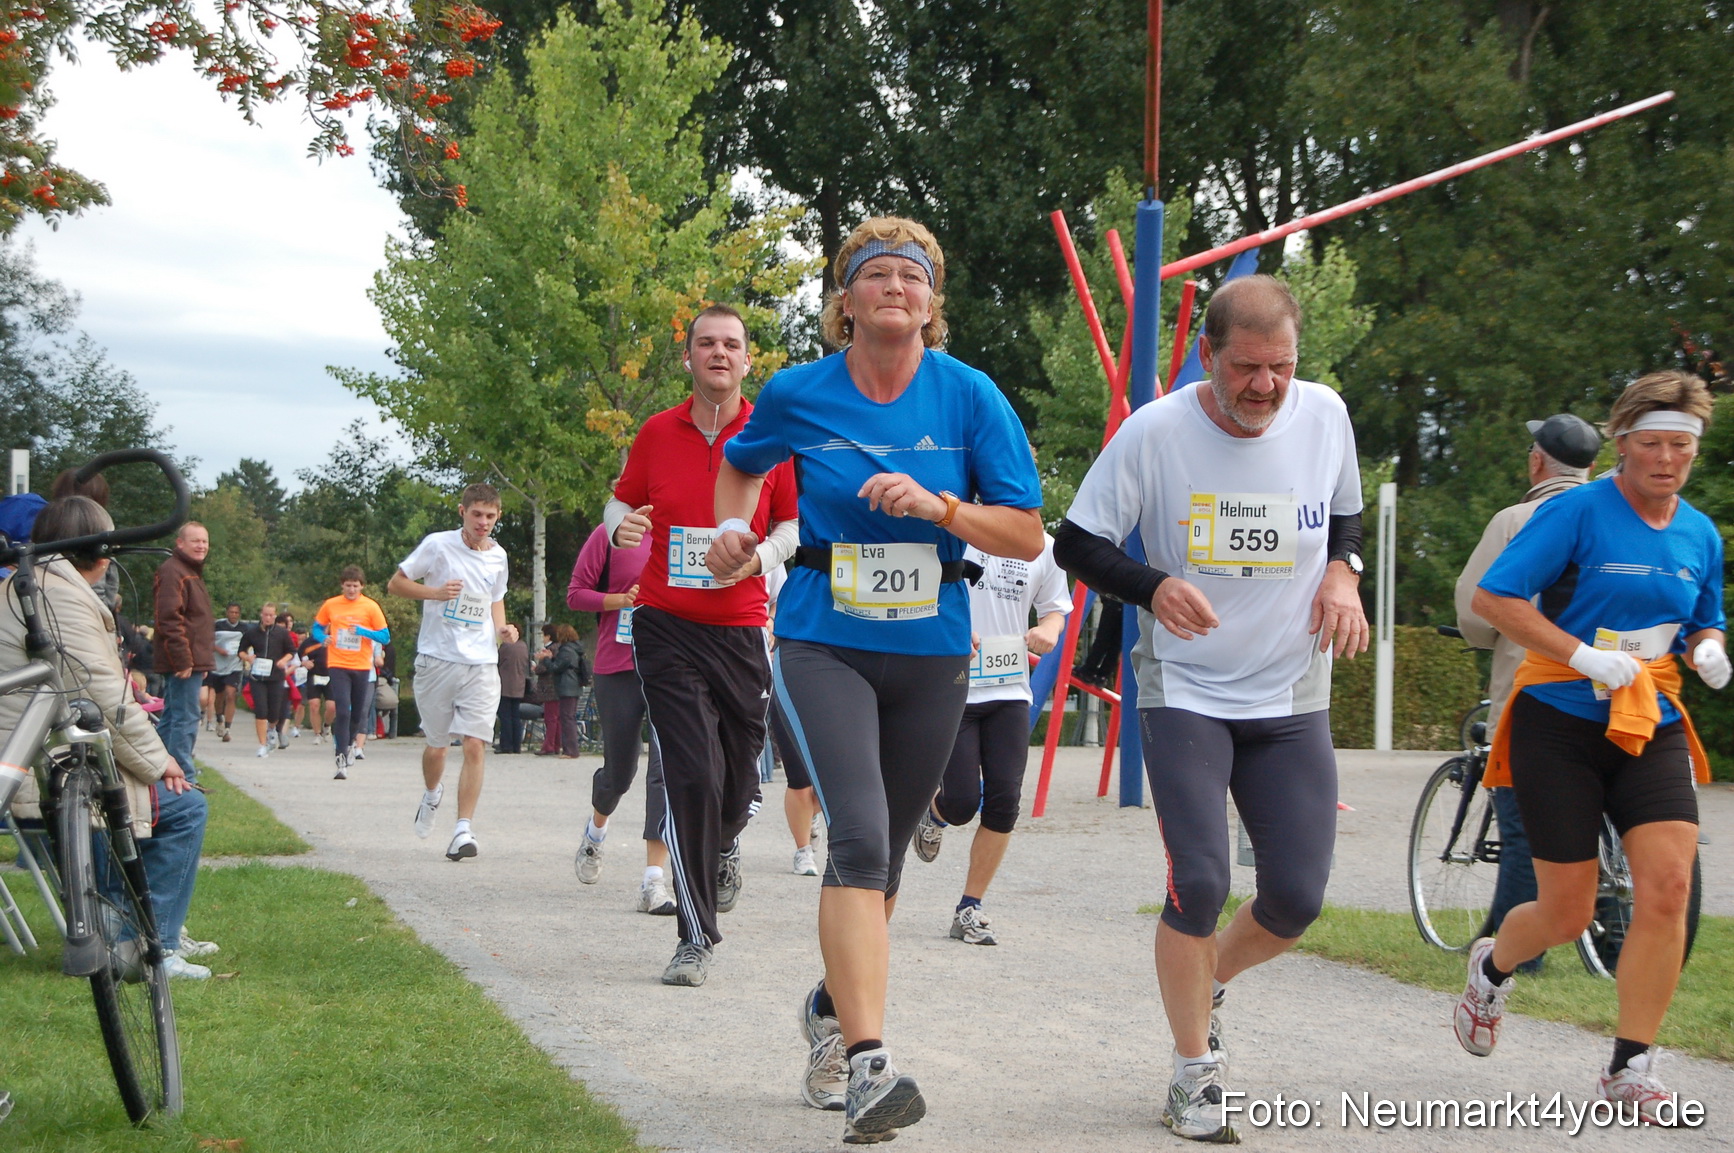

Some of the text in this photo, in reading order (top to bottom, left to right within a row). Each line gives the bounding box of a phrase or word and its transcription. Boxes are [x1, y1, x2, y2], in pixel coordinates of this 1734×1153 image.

[1220, 501, 1267, 518] Helmut
[1194, 526, 1201, 538] D
[686, 533, 715, 545] Bernh
[1229, 528, 1279, 552] 559
[861, 544, 885, 558] Eva
[836, 567, 844, 578] D
[1254, 567, 1293, 575] PFLEIDERER
[872, 568, 920, 592] 201
[977, 581, 988, 590] 9.
[460, 604, 485, 617] 2132
[898, 604, 936, 615] PFLEIDERER
[1620, 639, 1641, 652] Ilse
[986, 652, 1018, 669] 3502
